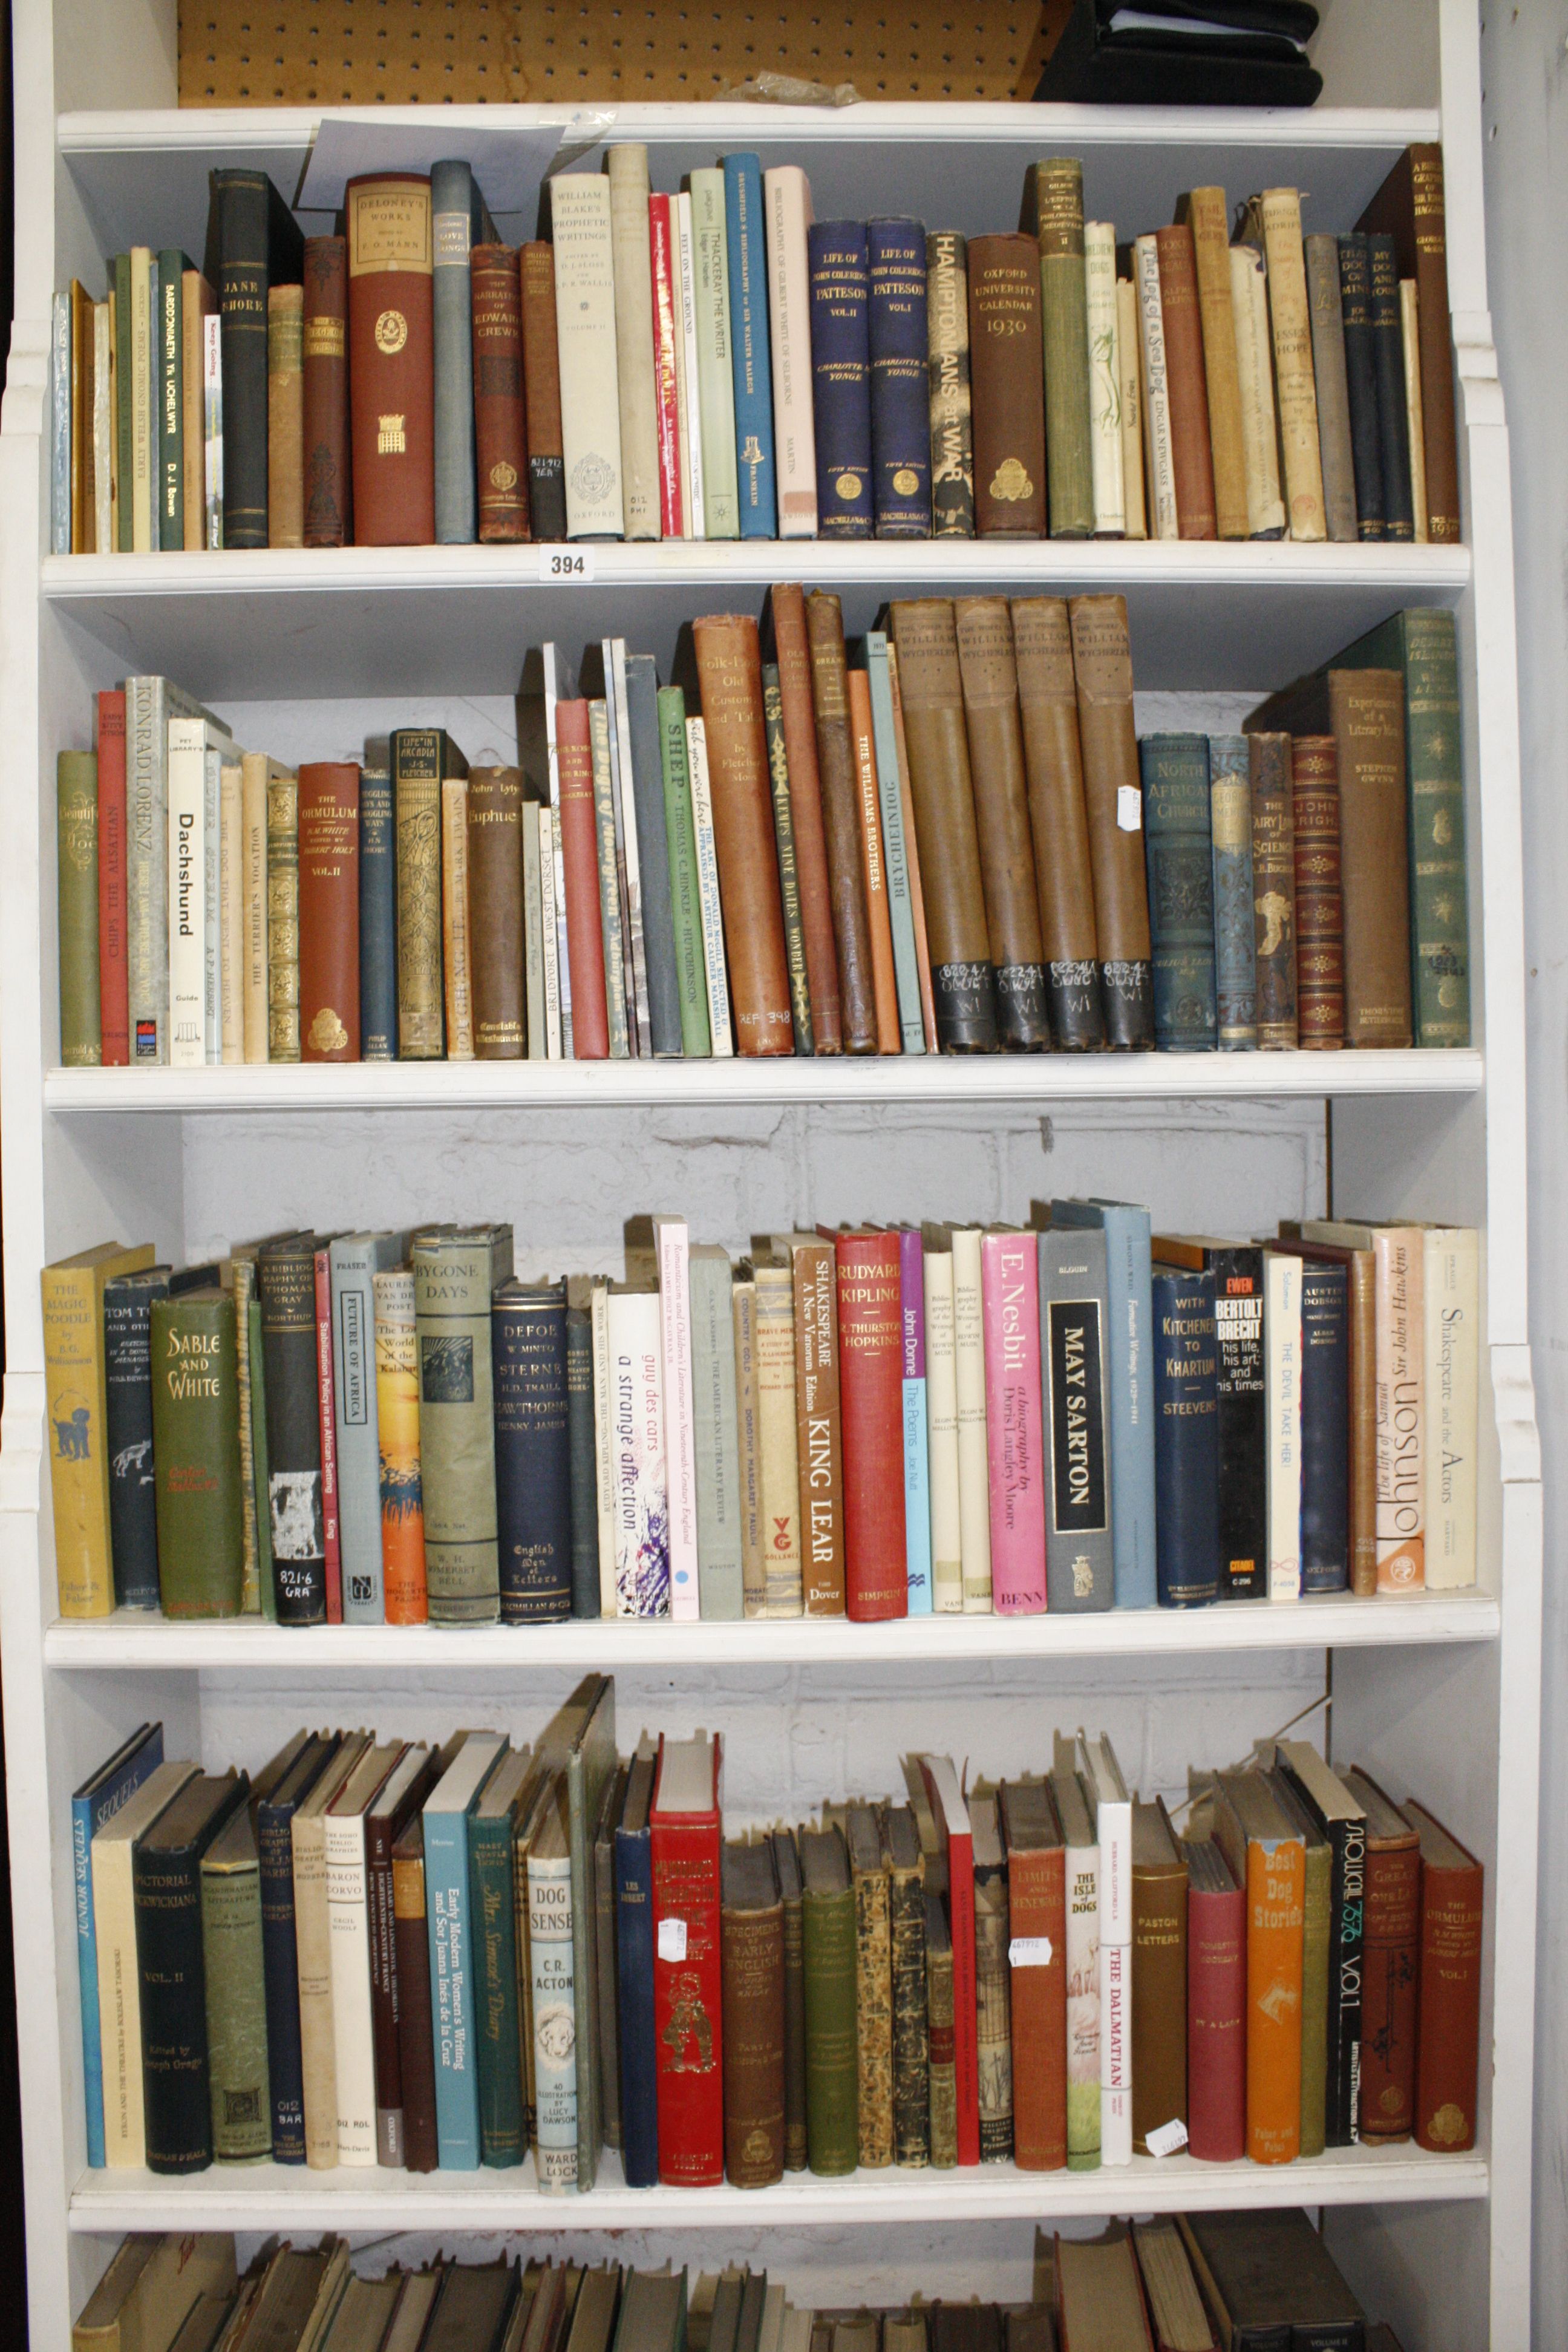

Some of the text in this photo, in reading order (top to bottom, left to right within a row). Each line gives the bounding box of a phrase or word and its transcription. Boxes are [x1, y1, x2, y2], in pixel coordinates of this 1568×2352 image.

[557, 191, 602, 200] WILLIAM
[561, 205, 601, 214] BLAKE'S
[554, 219, 610, 229] PROPHETIC
[558, 232, 607, 241] WRITINGS
[823, 253, 858, 264] LIFE OF
[881, 249, 916, 260] LIFE OF
[983, 269, 1027, 279] OXFORD
[224, 282, 257, 293] JANE
[817, 287, 867, 300] PATTESON
[874, 283, 925, 295] PATTESON
[975, 286, 1036, 297] UNIVERSITY
[711, 234, 725, 359] THACKERAY THE WRITER
[222, 299, 263, 313] SHORE
[979, 301, 1033, 312] CALENDAR
[987, 320, 1027, 337] 1930
[1277, 345, 1308, 354] HOPE
[936, 236, 963, 482] HAMPTONIANS at WAR
[828, 373, 862, 382] YONGE
[886, 368, 920, 377] YONGE
[1155, 400, 1168, 486] EDGAR NEWGASS
[786, 437, 795, 474] MARTIN
[750, 464, 758, 506] FRANKLIN
[551, 556, 585, 574] 394
[901, 634, 955, 644] WILLIAM
[136, 686, 151, 768] KONRAD
[400, 747, 435, 757] ARCADIA
[1157, 762, 1203, 778] NORTH
[136, 776, 152, 852] LORENZ
[302, 807, 356, 819] ORMULUM
[860, 735, 881, 891] THE WILLIAMS BROTHERS
[1157, 803, 1207, 818] CHURCH
[884, 781, 906, 898] BRYCHEINIOG
[106, 805, 119, 958] CHIPS THE ALSATIAN
[178, 814, 194, 936] Dachshund
[776, 797, 803, 972] KEMPS NINE DAIES WONDER
[251, 826, 261, 985] THE TERRIER'S VOCATION
[740, 1011, 790, 1025] REF 398
[415, 1264, 478, 1278] BYGONE
[838, 1264, 901, 1279] RUDYARD
[264, 1285, 313, 1294] THOMAS
[426, 1285, 468, 1298] DAYS
[1226, 1277, 1253, 1294] EWEN
[274, 1296, 303, 1304] GRAY
[841, 1287, 900, 1302] KIPLING
[1175, 1296, 1206, 1309] WITH
[1215, 1298, 1263, 1319] BERTOLT
[267, 1313, 312, 1322] NORTHUP
[815, 1260, 831, 1367] SHAKESPEARE
[1001, 1252, 1027, 1372] E. Nesbit
[1391, 1246, 1408, 1377] Sir John Hawkins
[503, 1325, 557, 1338] DEFOE
[1217, 1319, 1261, 1341] BRECHT
[166, 1328, 220, 1357] SABLE
[385, 1338, 414, 1347] World
[521, 1344, 555, 1353] MINTO
[802, 1282, 817, 1412] A New Variorum Edition
[844, 1336, 899, 1347] HOPKINS
[1185, 1341, 1201, 1352] TO
[1221, 1341, 1259, 1354] his life,
[179, 1357, 208, 1371] AND
[347, 1297, 360, 1417] FUTURE OF AFRICA
[500, 1363, 561, 1376] STERNE
[1230, 1367, 1251, 1379] and
[904, 1308, 920, 1446] John Donne The Poems
[168, 1370, 220, 1400] WHITE
[642, 1355, 659, 1452] guy des cars
[1163, 1401, 1217, 1415] STEEVENS
[1281, 1342, 1292, 1468] THE DEVIL TAKE HER!
[1437, 1308, 1464, 1504] Shakespeare and the Actors
[1065, 1327, 1089, 1504] MAY SARTON
[617, 1356, 638, 1530] a strange affection
[1002, 1387, 1018, 1530] Doris Langley Moore
[1375, 1382, 1425, 1549] Johnson
[808, 1419, 834, 1563] KING LEAR
[326, 1519, 336, 1540] King
[1229, 1559, 1255, 1572] CITADEL
[809, 1589, 840, 1601] Dover
[857, 1589, 901, 1601] SIMPKIN
[1001, 1590, 1043, 1606] BENN
[1264, 1853, 1296, 1870] Best
[74, 1818, 90, 1938] JUNIOR SEQUELS
[325, 1872, 360, 1881] BARON
[1076, 1873, 1094, 1883] THE
[325, 1885, 362, 1895] CORVO
[536, 1887, 566, 1904] DOG
[1074, 1884, 1096, 1895] ISLE
[1267, 1878, 1293, 1903] Dog
[1072, 1901, 1097, 1913] DOGS
[531, 1913, 573, 1930] SENSE
[1138, 1918, 1178, 1928] PASTON
[1254, 1906, 1301, 1928] Stories
[1137, 1935, 1180, 1945] LETTERS
[544, 1959, 566, 1972] C.R.
[435, 1891, 452, 2066] and Sor Juana Inés de la Cruz
[447, 1887, 466, 2071] Early Modern Women's Writing
[536, 1976, 573, 1990] ACTON
[1110, 1949, 1122, 2087] THE DALMATIAN
[542, 2116, 576, 2125] DAWSON
[546, 2153, 577, 2163] WARD
[546, 2166, 578, 2177] LOCK
